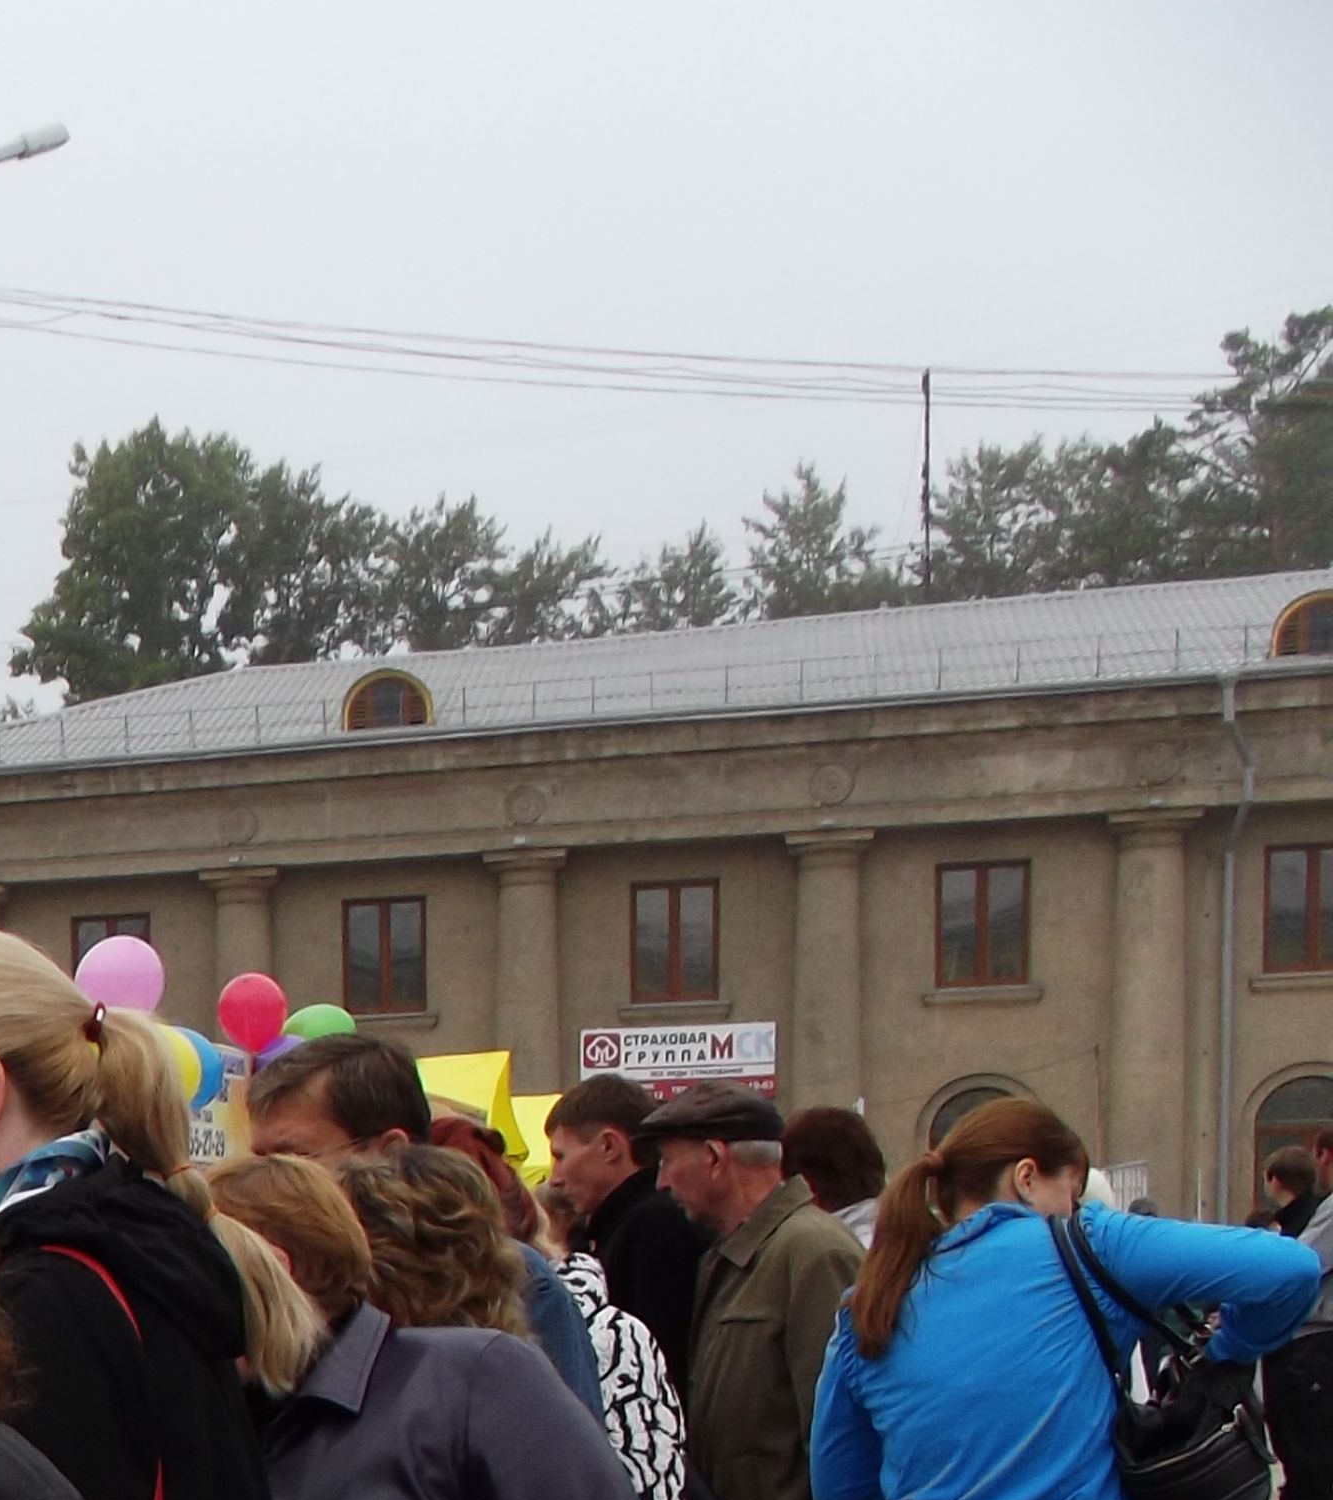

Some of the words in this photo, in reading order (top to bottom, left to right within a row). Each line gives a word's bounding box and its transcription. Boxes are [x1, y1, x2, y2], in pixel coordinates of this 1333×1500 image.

[623, 1032, 707, 1046] СТРАХОВАЯ
[710, 1030, 773, 1060] МСК
[624, 1049, 707, 1064] ГРУППА
